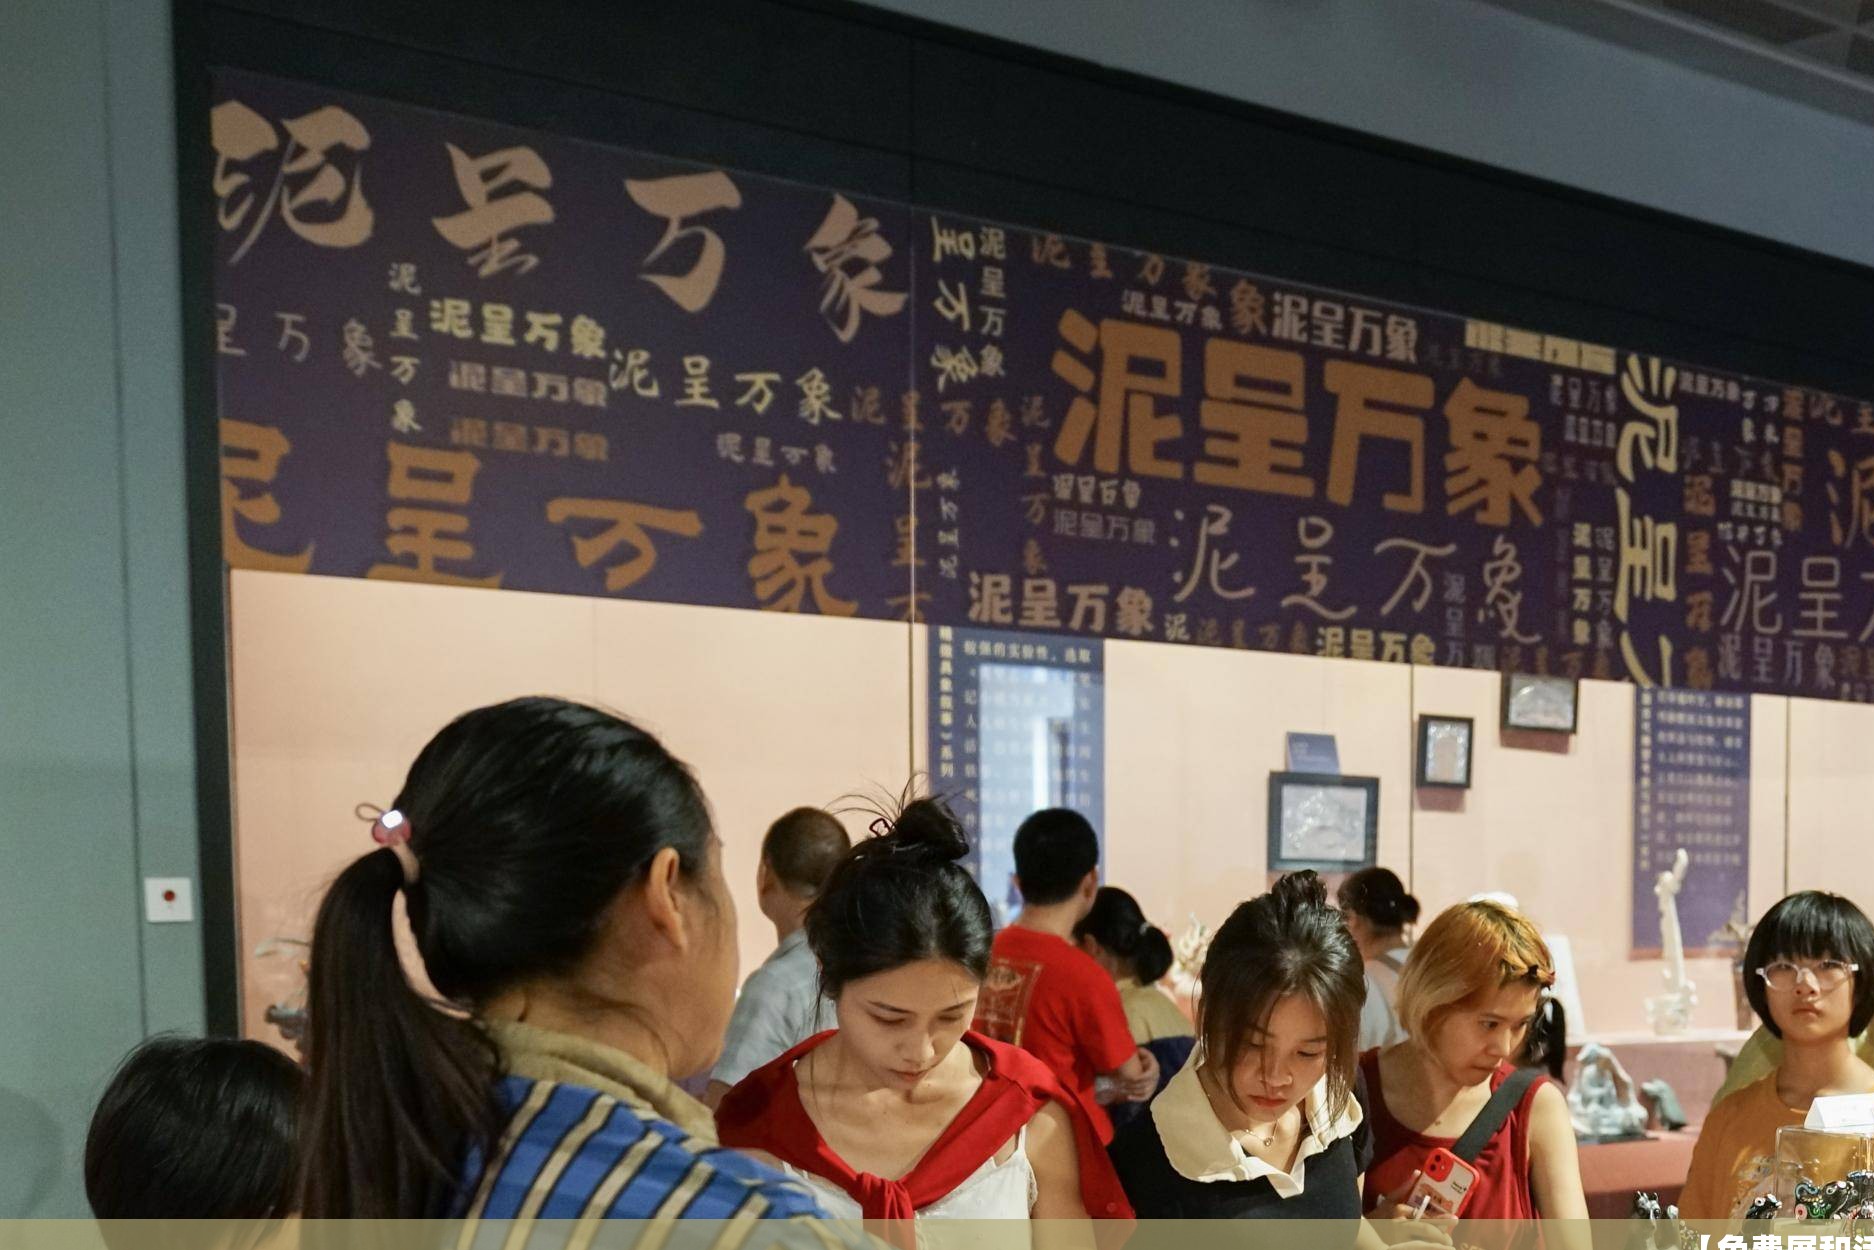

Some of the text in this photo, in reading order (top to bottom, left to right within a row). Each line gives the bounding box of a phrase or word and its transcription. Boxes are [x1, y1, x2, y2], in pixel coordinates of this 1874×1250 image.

[429, 298, 608, 360] 泥呈万象
[1271, 290, 1419, 366] 泥呈万象
[608, 349, 844, 426] 泥呈万象
[1051, 308, 1545, 528] 泥呈万象
[967, 570, 1154, 637] 泥呈万象
